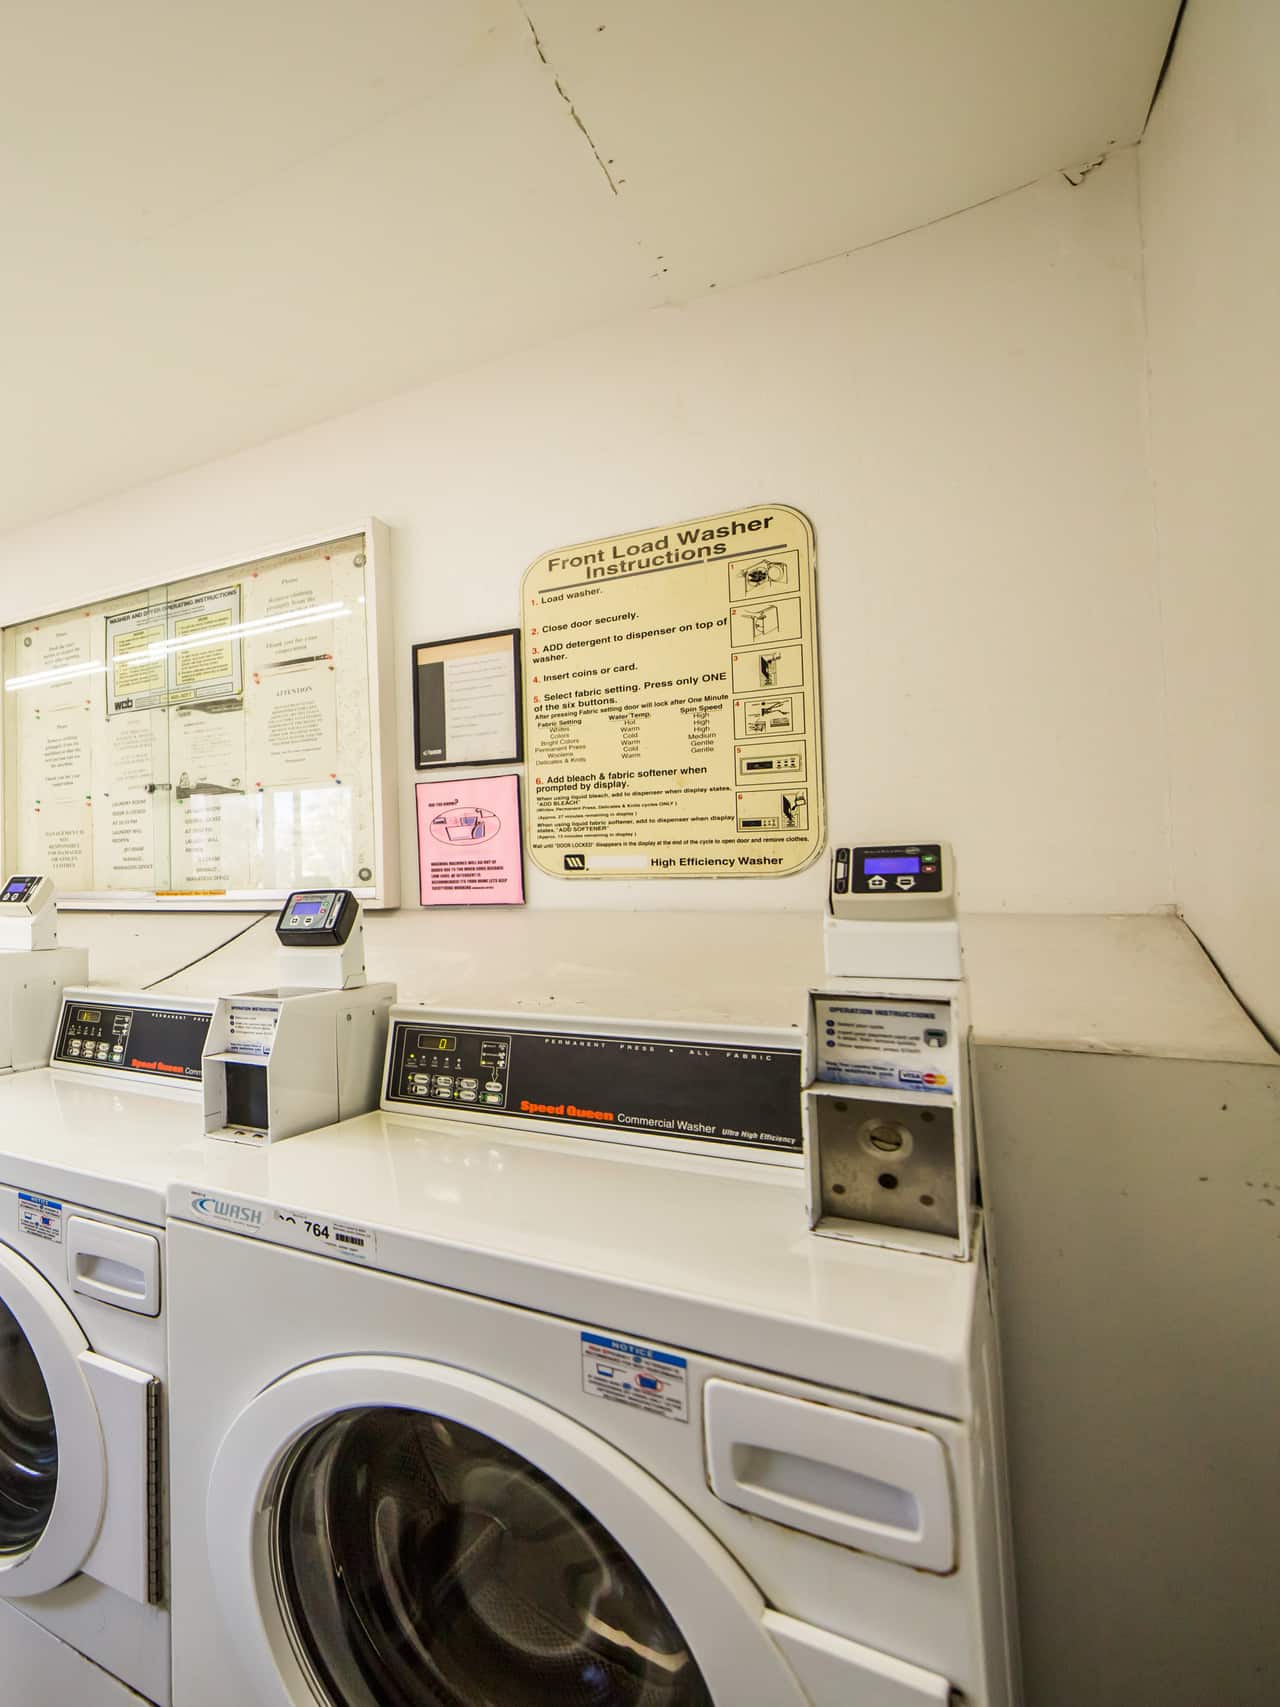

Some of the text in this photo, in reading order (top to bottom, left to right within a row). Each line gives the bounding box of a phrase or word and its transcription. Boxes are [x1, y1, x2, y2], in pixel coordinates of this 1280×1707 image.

[548, 516, 774, 572] Front Load Washer
[586, 542, 727, 579] Instructions
[541, 593, 564, 604] Load
[567, 588, 603, 600] washer.
[542, 623, 568, 633] Close
[570, 618, 592, 629] door
[595, 611, 639, 625] securely.
[542, 643, 563, 653] ADD
[566, 635, 611, 649] detergent
[626, 626, 676, 641] dispenser
[679, 624, 693, 632] on
[695, 620, 713, 631] top
[716, 617, 728, 627] of
[532, 653, 568, 664] washer.
[543, 672, 570, 682] Insert
[572, 668, 598, 678] coins
[613, 663, 638, 673] card.
[544, 692, 572, 702] Select
[574, 688, 602, 698] fabric
[604, 684, 642, 695] setting.
[644, 680, 673, 690] Press
[675, 676, 699, 686] only
[701, 672, 728, 682] ONE
[534, 697, 618, 712] of the six buttons.
[547, 775, 565, 784] Add
[567, 773, 596, 783] bleach
[599, 772, 605, 780] &
[608, 770, 634, 780] fabric
[637, 768, 677, 778] softener
[680, 765, 707, 775] when
[536, 780, 630, 794] prompted by display.
[651, 855, 784, 869] High Efficiency Washer
[438, 1038, 447, 1050] 0
[544, 1038, 772, 1061] PERMANENT PRESS ALL FABRIC
[520, 1100, 796, 1145] Speed Queen Commercial Washer Ultra High Efficiency
[214, 1201, 262, 1224] WASH
[304, 1220, 330, 1239] 764
[611, 1341, 654, 1357] NOTICE
